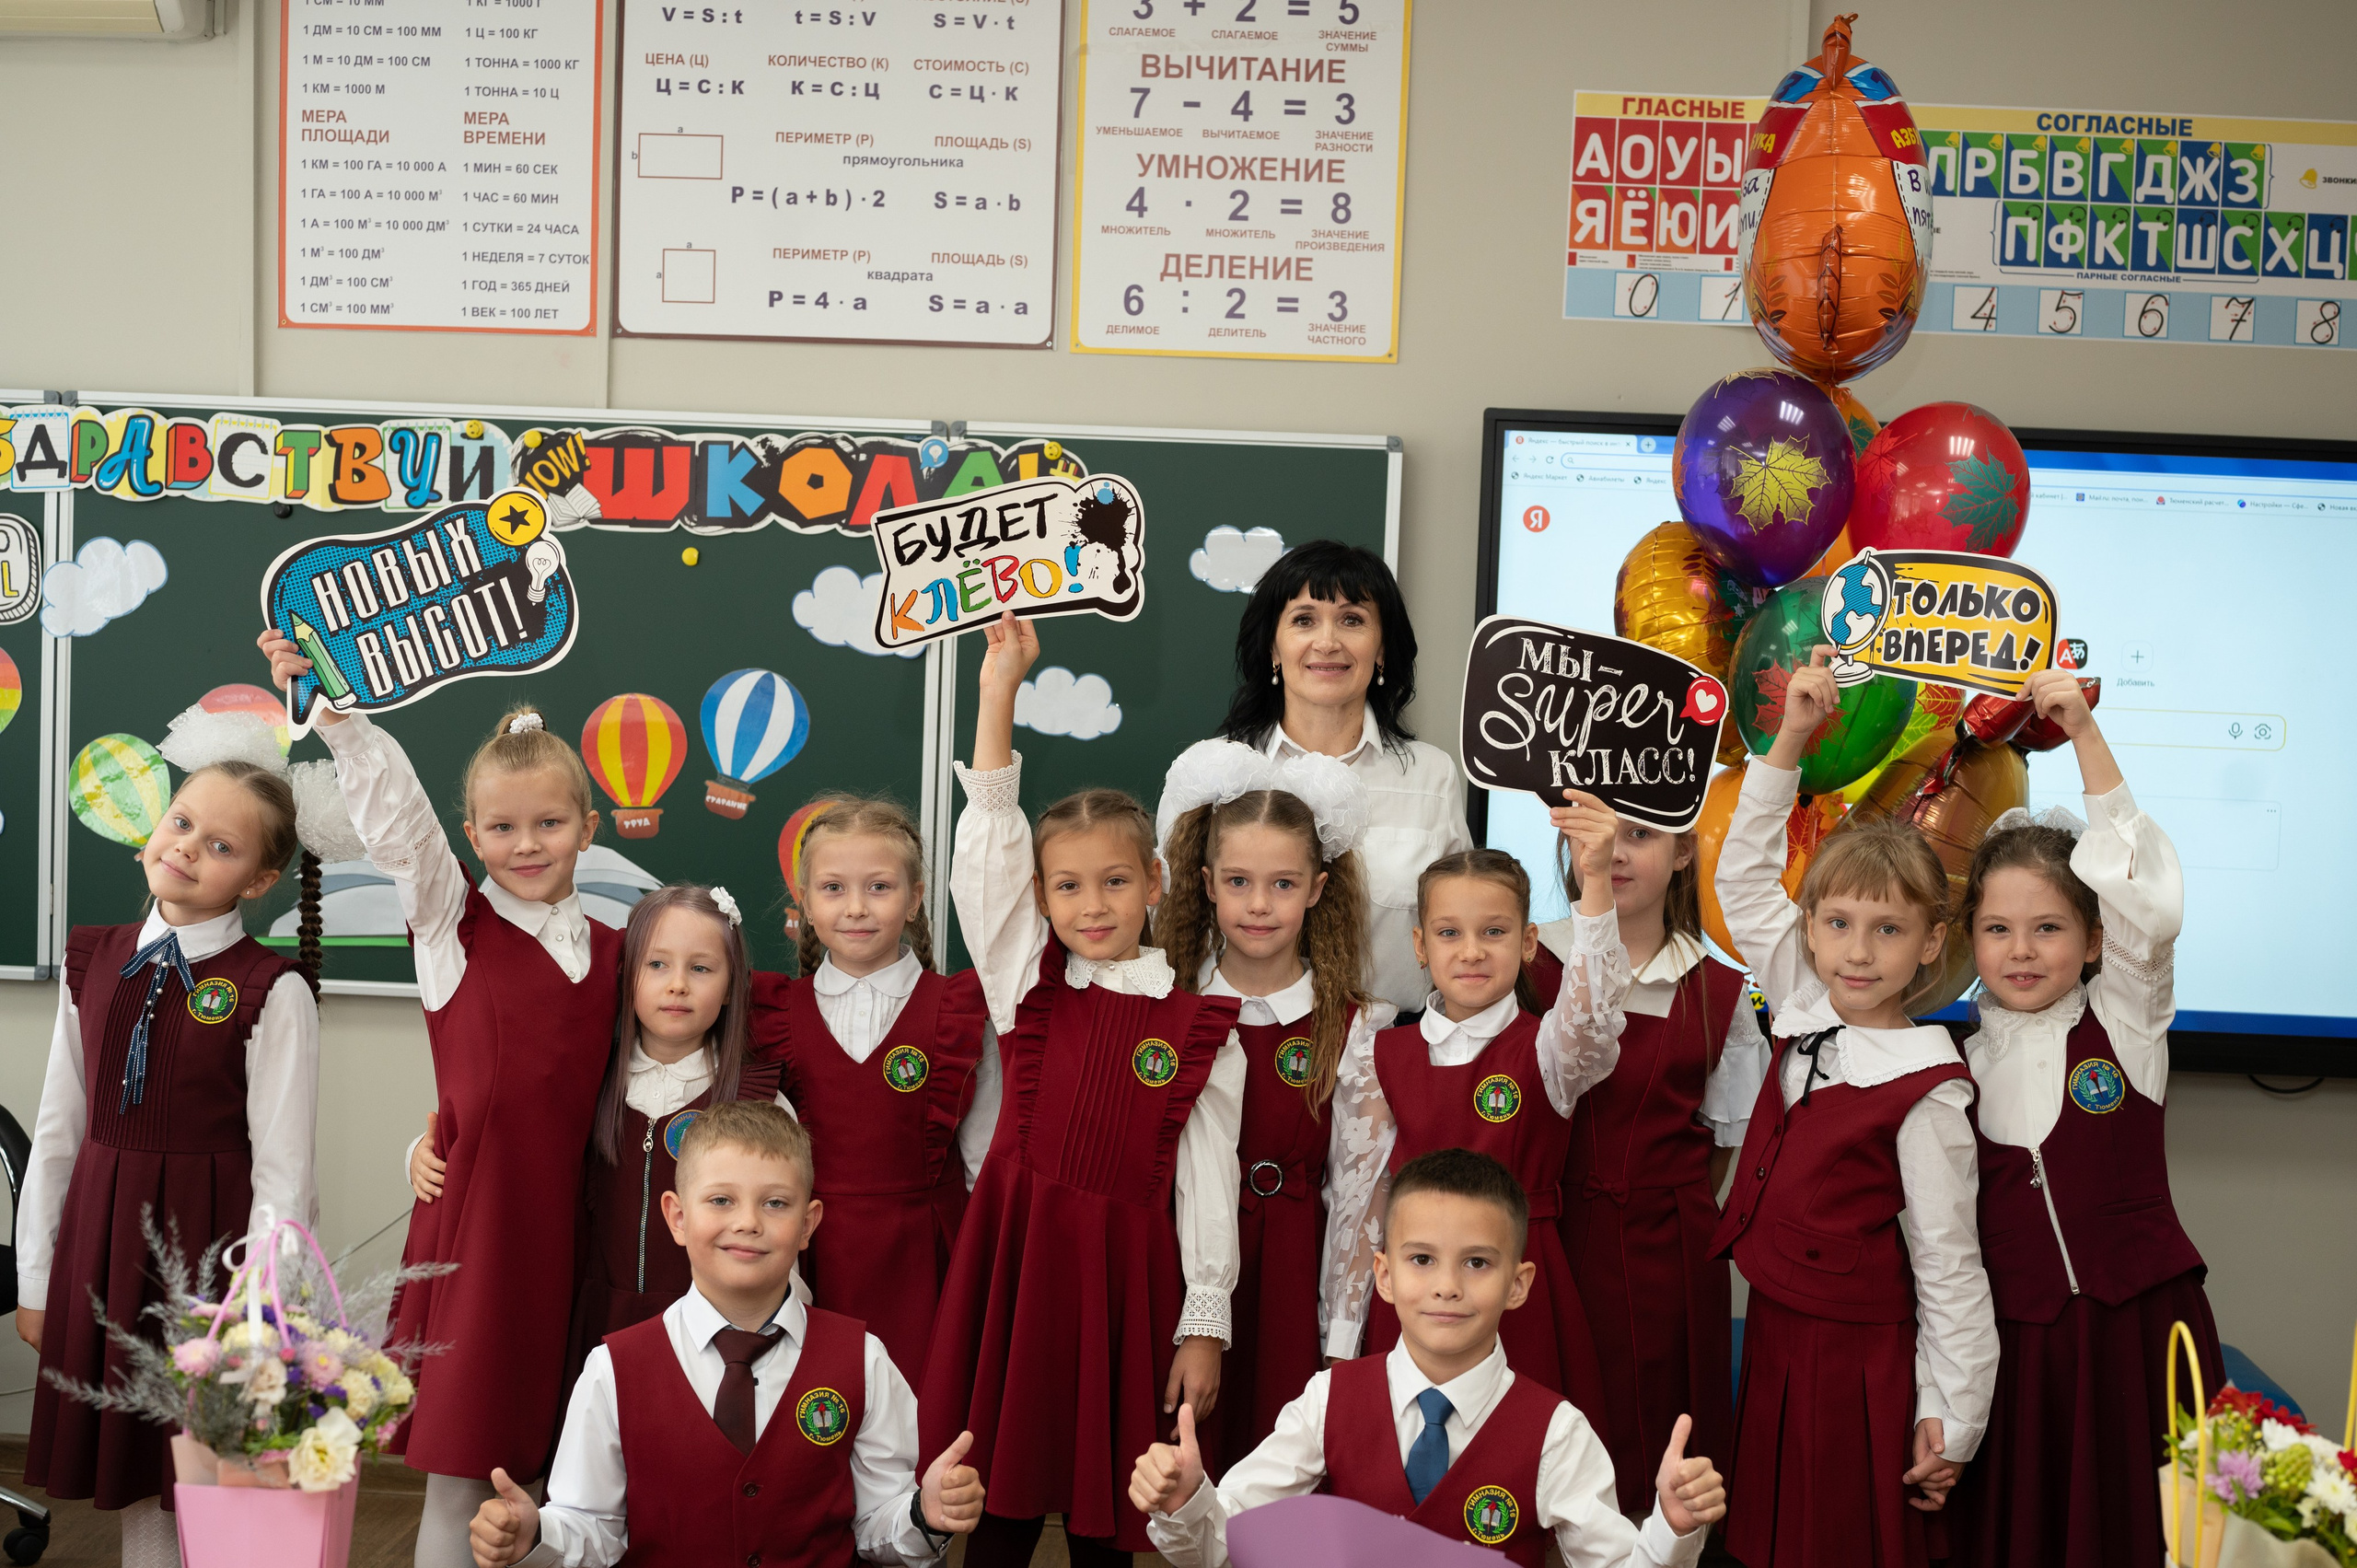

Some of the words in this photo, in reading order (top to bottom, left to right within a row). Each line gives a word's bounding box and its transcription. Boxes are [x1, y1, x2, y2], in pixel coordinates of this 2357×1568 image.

[312, 24, 332, 37] ДМ
[346, 25, 360, 36] 10
[363, 25, 382, 36] СМ
[397, 26, 418, 37] 100
[421, 26, 442, 37] ММ
[1109, 27, 1177, 38] СЛАГАЕМОЕ
[1211, 29, 1279, 41] СЛАГАЕМОЕ
[1318, 29, 1377, 41] ЗНАЧЕНИЕ
[1325, 42, 1369, 52] СУММЫ
[474, 57, 519, 69] ТОННА
[533, 58, 562, 70] 1000
[564, 59, 580, 70] КГ
[644, 52, 686, 67] ЦЕНА
[689, 53, 709, 68] (Ц)
[768, 54, 867, 69] КОЛИЧЕСТВО
[913, 58, 1005, 73] СТОИМОСТЬ
[1142, 54, 1345, 83] ВЫЧИТАНИЕ
[474, 86, 519, 98] ТОННА
[1131, 87, 1150, 118] 7
[1231, 90, 1253, 122] 4
[1335, 93, 1355, 124] 3
[1620, 98, 1745, 122] ГЛАСНЫЕ
[301, 109, 347, 123] МЕРА
[463, 110, 510, 126] МЕРА
[1096, 125, 1183, 138] УМЕНЬШАЕМОЕ
[2035, 113, 2192, 138] СОГЛАСНЫЕ
[301, 128, 389, 145] ПЛОЩАДИ
[463, 130, 546, 145] ВРЕМЕНИ
[775, 131, 852, 145] ПЕРИМЕТР
[1202, 129, 1281, 141] ВЫЧИТАЕМОЕ
[1315, 130, 1374, 141] ЗНАЧЕНИЕ
[935, 135, 1009, 151] ПЛОЩАДЬ
[1013, 137, 1032, 152] (S)
[1315, 142, 1374, 153] РАЗНОСТИ
[473, 162, 502, 174] МИН
[516, 163, 529, 174] 60
[532, 163, 559, 175] СЕК
[842, 156, 964, 169] прямоугольника
[1137, 154, 1345, 182] УМНОЖЕНИЕ
[472, 192, 499, 203] ЧАС
[513, 192, 528, 203] 60
[530, 193, 559, 204] МИН
[1126, 187, 1147, 217] 4
[1228, 190, 1249, 221] 2
[1331, 192, 1351, 224] 8
[472, 221, 513, 233] СУТКИ
[527, 223, 541, 234] 24
[544, 224, 580, 235] ЧАСА
[1100, 225, 1172, 237] МНОЖИТЕЛЬ
[1205, 227, 1276, 239] МНОЖИТЕЛЬ
[1311, 228, 1370, 240] ЗНАЧЕНИЕ
[772, 247, 849, 261] ПЕРИМЕТР
[1295, 240, 1386, 253] ПРОИЗВЕДЕНИЯ
[471, 251, 524, 264] НЕДЕЛЯ
[538, 252, 545, 263] 7
[548, 253, 590, 265] СУТОК
[931, 251, 1006, 267] ПЛОЩАДЬ
[1009, 254, 1028, 269] (S)
[1160, 253, 1313, 282] ДЕЛЕНИЕ
[866, 271, 934, 284] квадрата
[2076, 272, 2119, 281] ПАРНЫЕ
[2120, 272, 2184, 285] СОГЛАСНЫЕ
[471, 280, 497, 293] ГОД
[511, 281, 532, 292] 365
[534, 279, 570, 294] ДНЕЙ
[1629, 273, 1658, 317] 0
[1124, 285, 1144, 316] 6
[1225, 288, 1246, 319] 2
[1328, 291, 1348, 322] 3
[471, 307, 496, 318] ВЕК
[510, 308, 531, 319] 100
[534, 308, 559, 319] ЛЕТ
[1971, 287, 1996, 331] 4
[2049, 290, 2084, 333] 5
[2138, 295, 2168, 337] 6
[2225, 296, 2255, 341] 7
[2311, 301, 2340, 343] 8
[1105, 324, 1160, 335] ДЕЛИМОЕ
[1207, 327, 1267, 339] ДЕЛИТЕЛЬ
[1307, 322, 1366, 334] ЗНАЧЕНИЕ
[1306, 334, 1367, 346] ЧАСТНОГО
[892, 493, 1058, 566] БУДЕТ
[312, 517, 482, 633] НОВЫХ
[890, 545, 1084, 640] КЛЁВО!
[1892, 580, 2041, 623] ТОЛЬКО
[356, 576, 528, 697] ВЫСОТ!
[1882, 628, 2043, 672] ВПЕРЕД!
[2116, 678, 2156, 688] Добавить
[1480, 672, 1684, 761] Super
[1548, 747, 1696, 786] КЛАСС!
[192, 981, 227, 997] ГИМНАЗИЯ
[1136, 1040, 1168, 1057] ГИМНАЗИЯ
[2072, 1062, 2099, 1090] ГИМНАЗИЯ
[1477, 1077, 1508, 1098] ГИМНАЗИЯ
[799, 1391, 830, 1419] ГИМНАЗИЯ
[1468, 1489, 1506, 1511] ГИМНАЗИЯ
